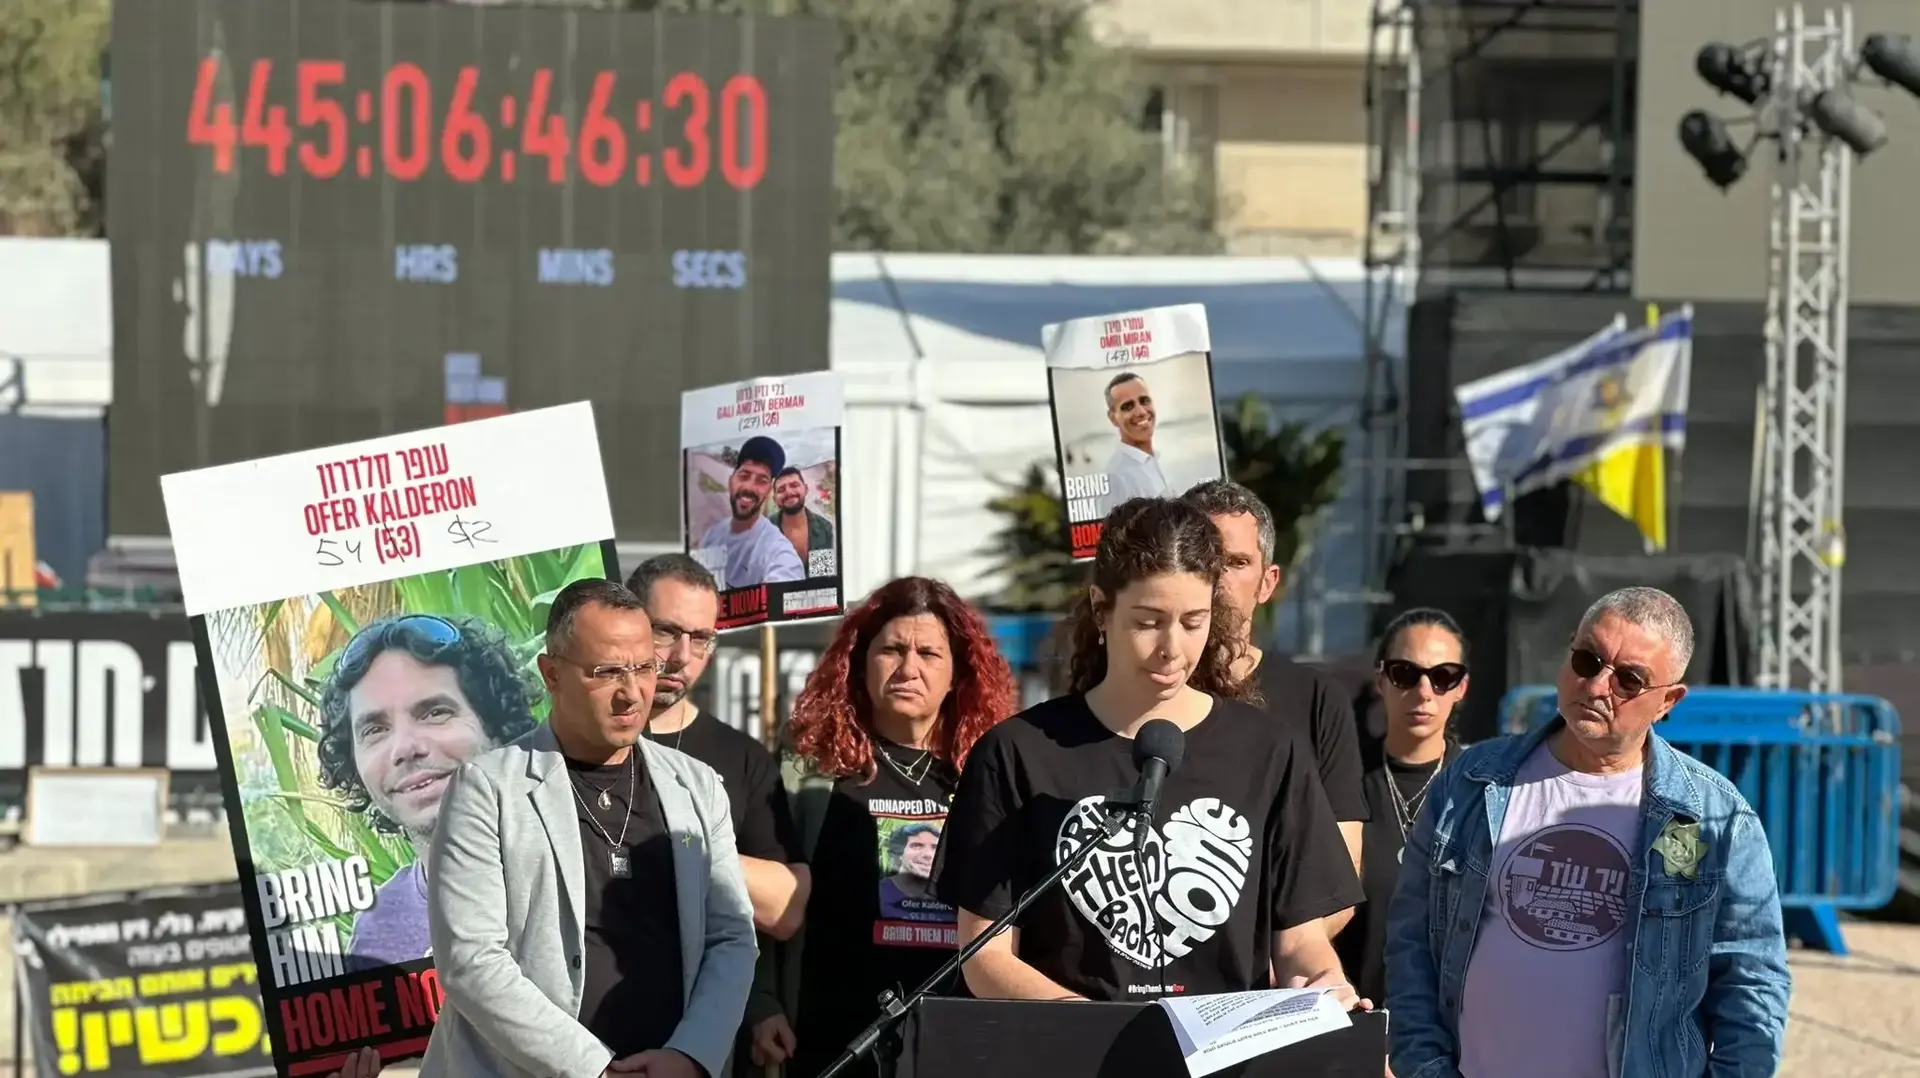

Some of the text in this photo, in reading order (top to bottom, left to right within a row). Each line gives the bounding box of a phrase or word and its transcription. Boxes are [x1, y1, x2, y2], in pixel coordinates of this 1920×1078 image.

[206, 239, 746, 289] DAYS HRS MINS SECS
[1100, 330, 1152, 349] OMRI MIRAN
[717, 395, 805, 420] GALI AND ZIV BERMAN
[316, 443, 449, 499] עופר קלדרון
[1066, 473, 1110, 499] BRING
[304, 476, 477, 536] OFER KALDERON
[1069, 498, 1097, 522] HIM
[375, 522, 421, 564] (53)
[1072, 524, 1103, 548] HOM
[316, 538, 362, 566] 54
[730, 584, 768, 617] NOW!
[869, 798, 923, 815] KIDNAPPED
[925, 799, 937, 814] BY
[257, 856, 374, 928] BRING
[1596, 868, 1625, 896] ניר
[901, 899, 953, 911] Ofer Kalder
[883, 925, 959, 945] BRING THEM HO
[268, 923, 344, 989] HIM
[280, 968, 447, 1054] HOME NO
[51, 995, 268, 1076] כשיו!
